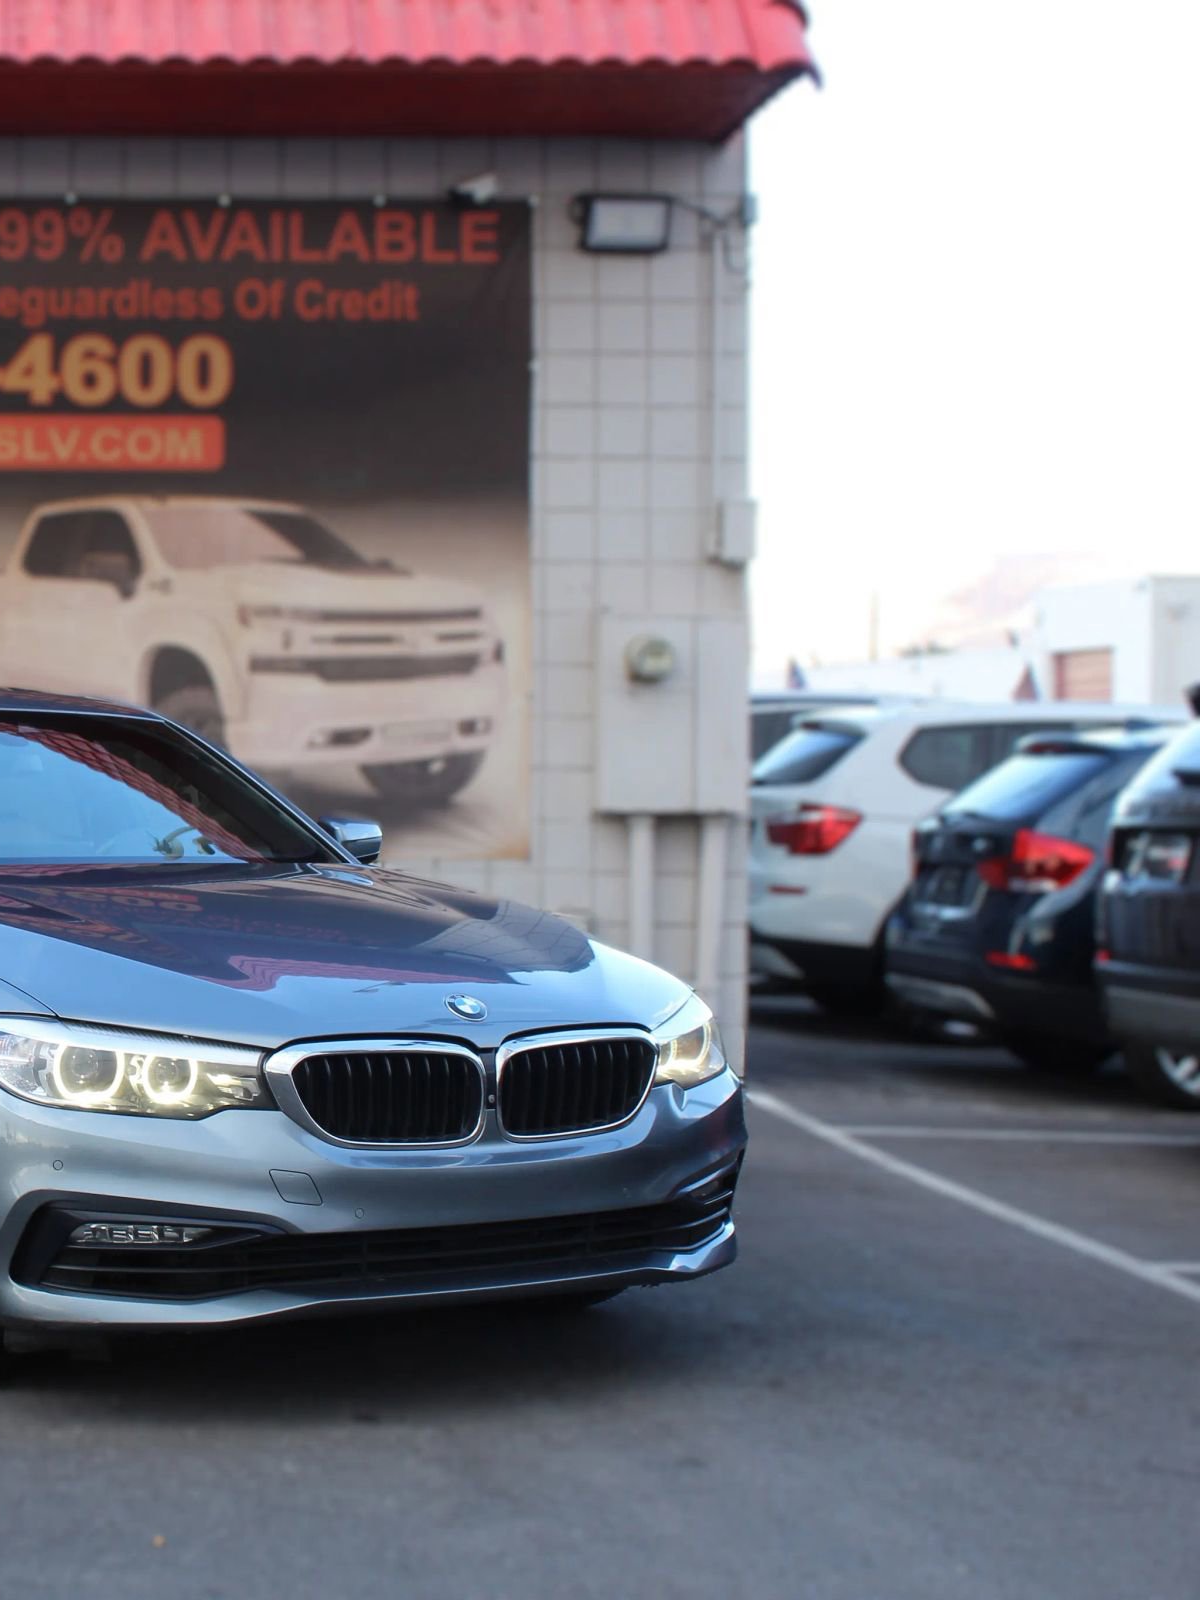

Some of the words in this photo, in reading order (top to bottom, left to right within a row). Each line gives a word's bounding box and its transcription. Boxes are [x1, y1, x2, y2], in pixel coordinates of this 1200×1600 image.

[140, 210, 500, 264] AVAILABLE
[234, 279, 286, 321] Of
[293, 280, 419, 322] Credit
